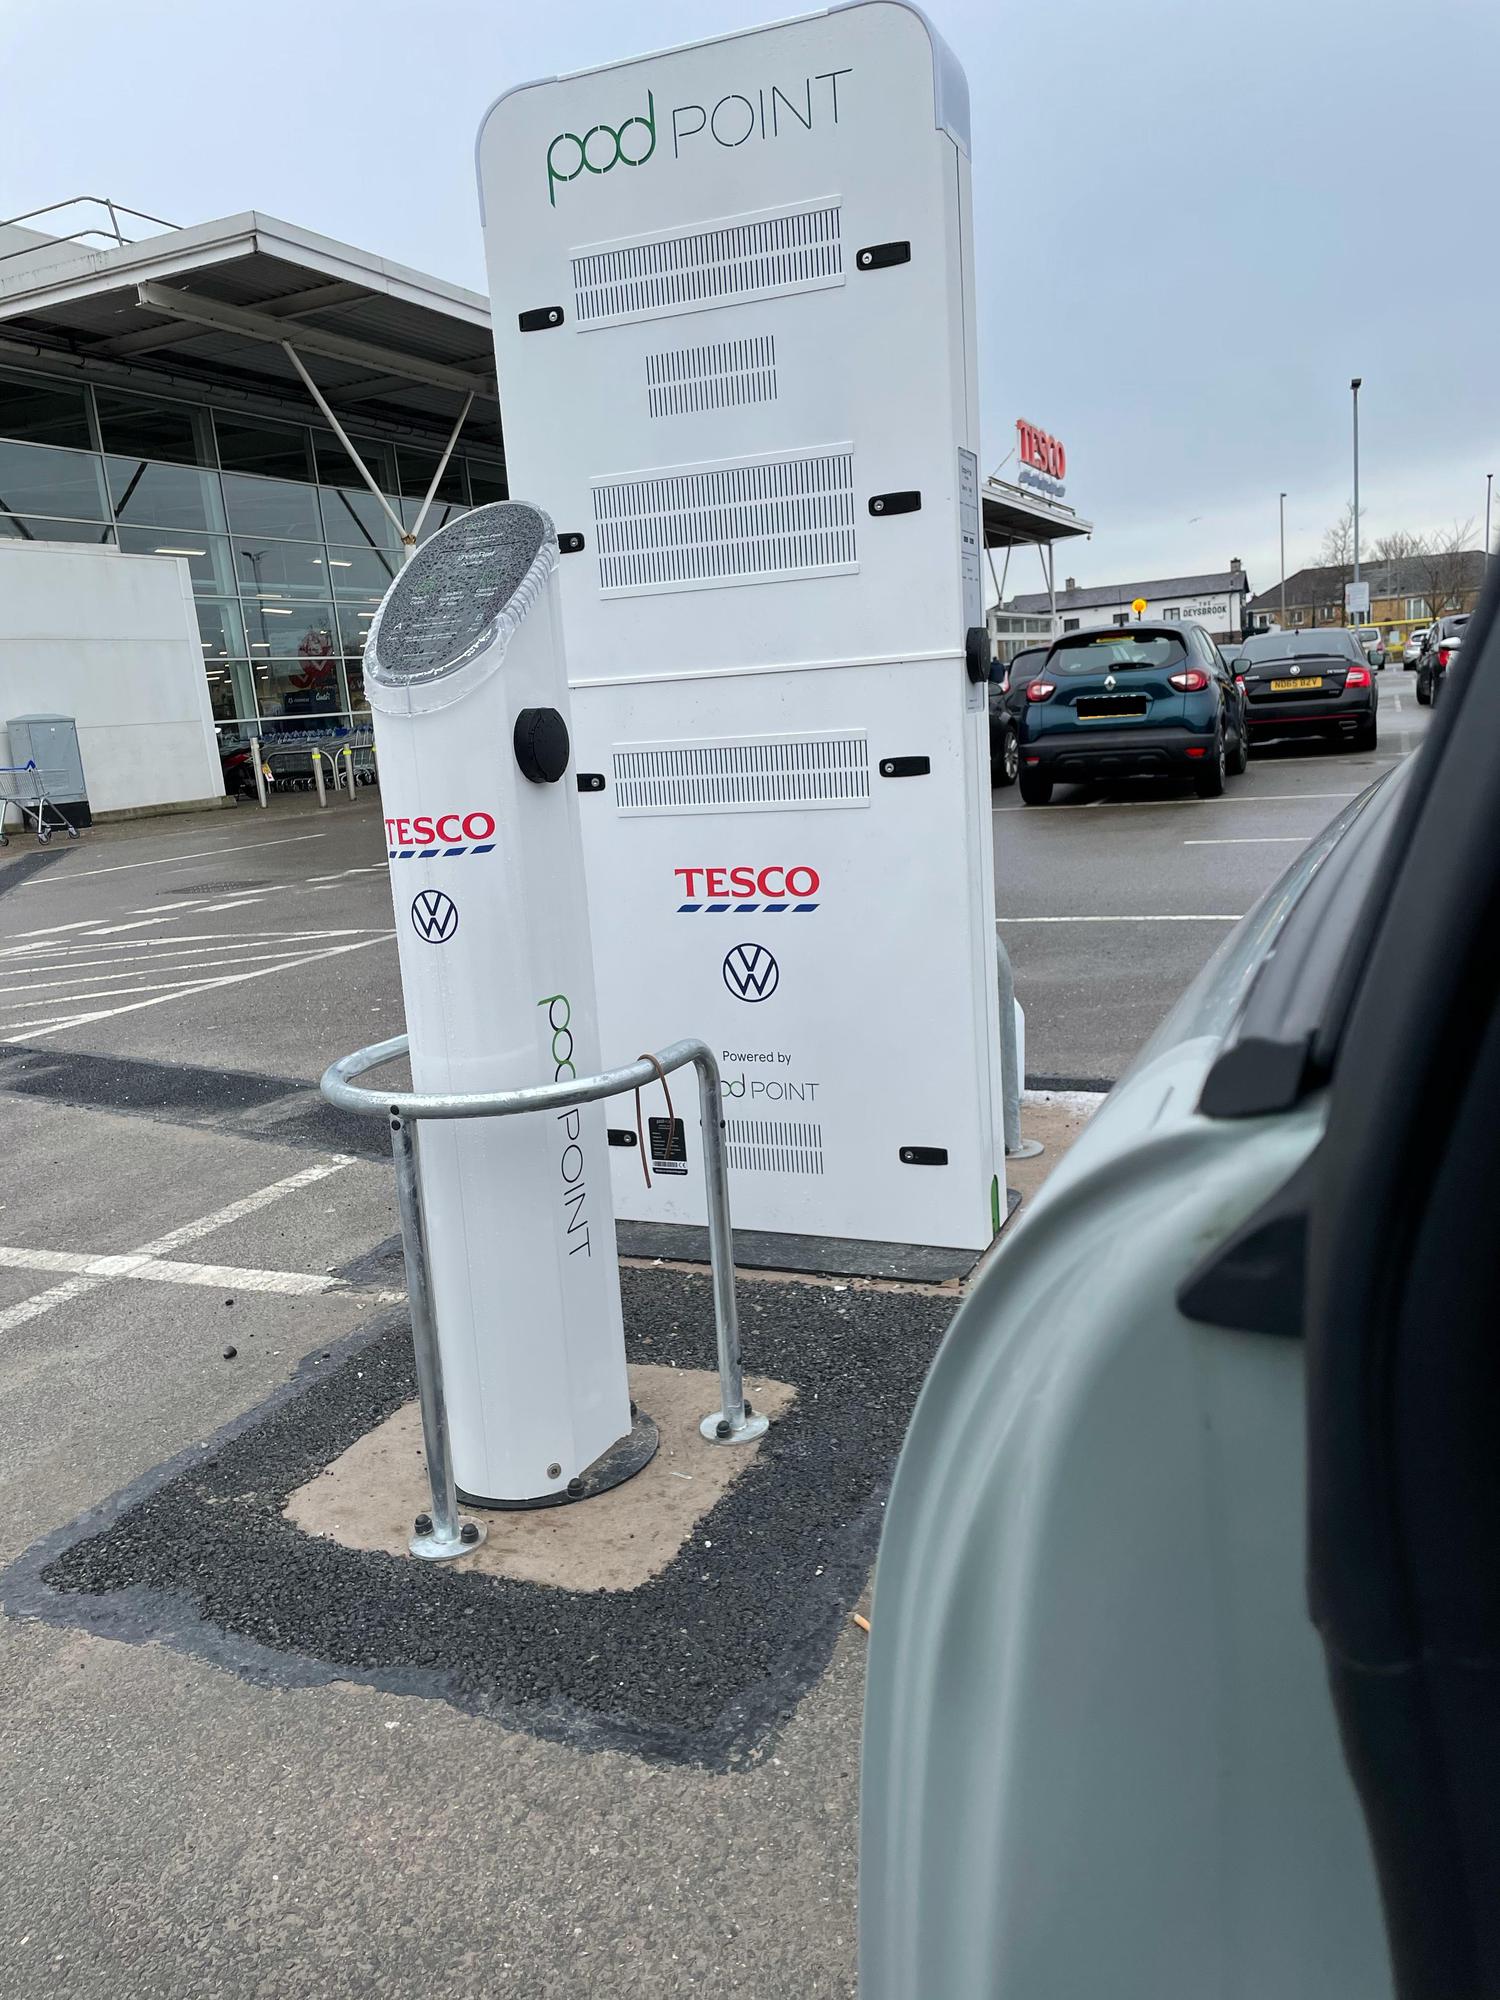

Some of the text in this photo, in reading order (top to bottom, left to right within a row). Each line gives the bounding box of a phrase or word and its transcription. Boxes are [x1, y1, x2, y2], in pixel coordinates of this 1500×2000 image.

[547, 68, 853, 208] pod POINT
[1016, 418, 1066, 480] TESCO
[1183, 605, 1228, 617] DEYSBROOK
[385, 812, 496, 845] TESCO
[674, 866, 820, 898] TESCO
[723, 1051, 791, 1066] Powered by
[721, 1073, 820, 1100] od POINT
[557, 1108, 591, 1257] POINT
